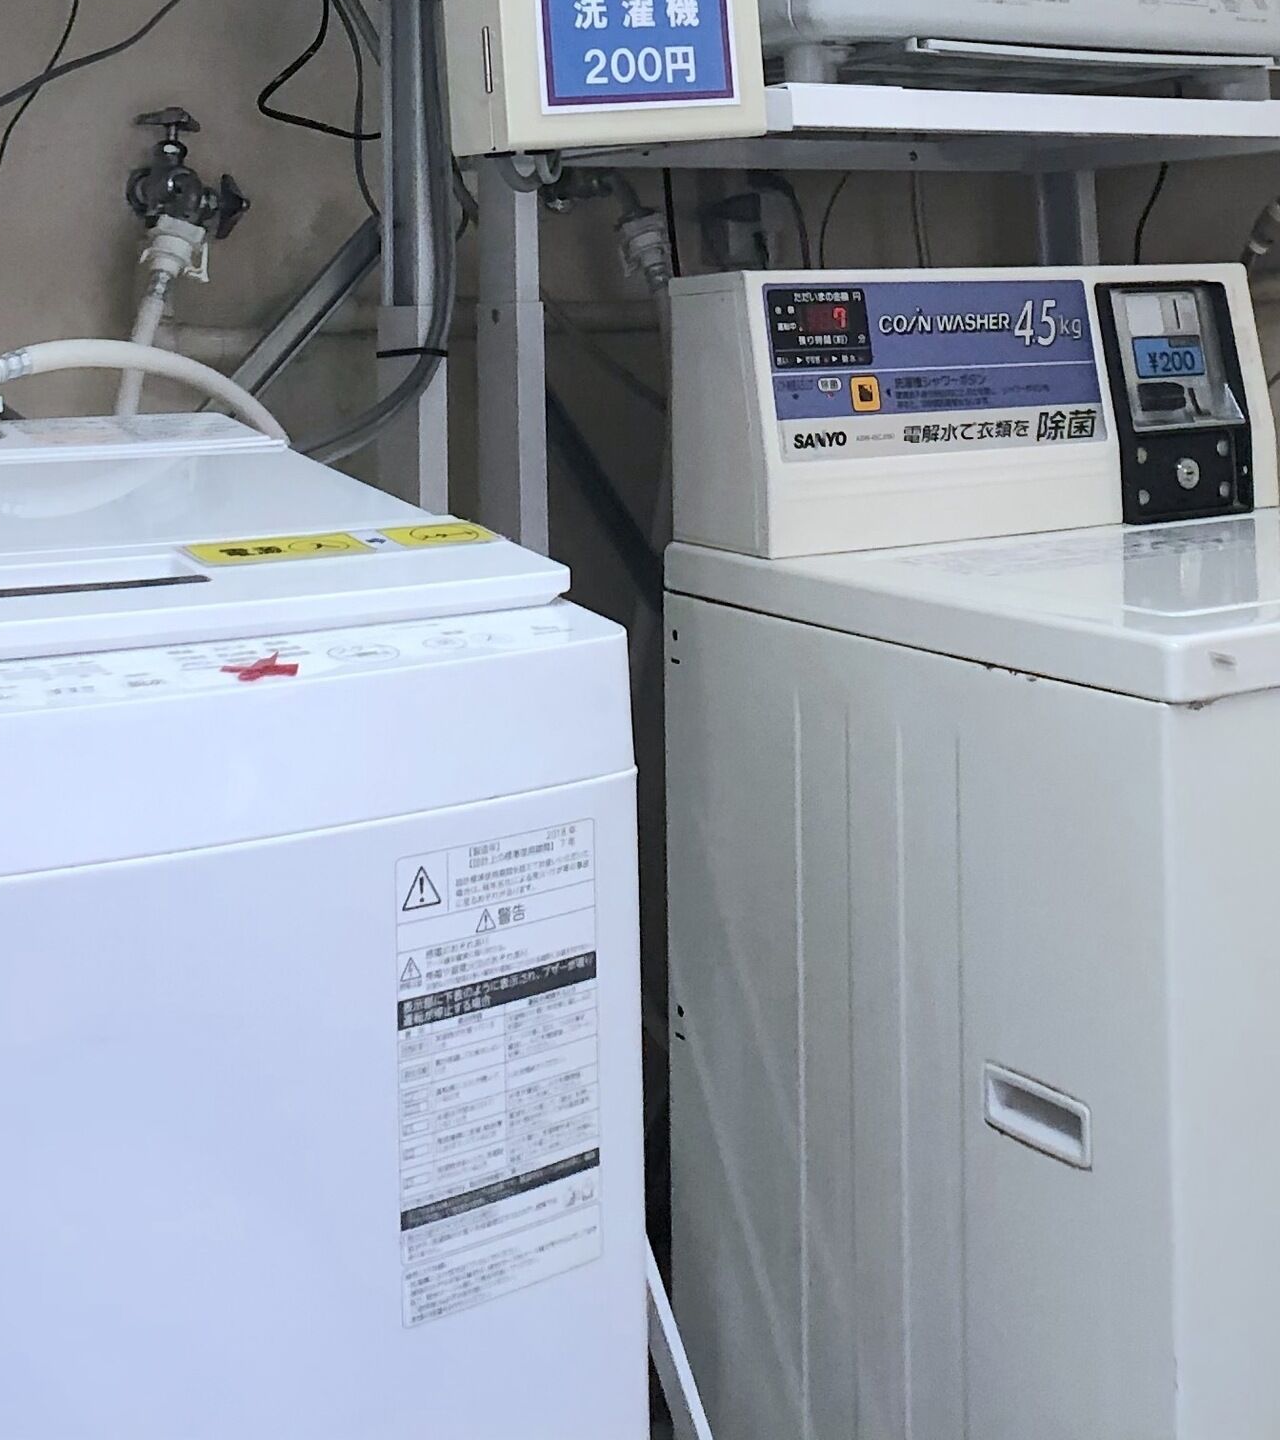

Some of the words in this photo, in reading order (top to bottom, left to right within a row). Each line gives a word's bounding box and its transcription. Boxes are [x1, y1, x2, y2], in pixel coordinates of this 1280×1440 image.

[584, 46, 697, 84] 200円
[793, 291, 850, 303] ただいまの金額
[852, 291, 862, 302] 円
[936, 312, 1011, 333] WASHER
[1059, 314, 1082, 339] kg
[1148, 350, 1196, 374] ¥200
[903, 419, 1030, 444] 電解水で衣類を
[1036, 408, 1097, 442] 除菌
[793, 430, 847, 450] SANYO
[497, 904, 526, 925] 警告
